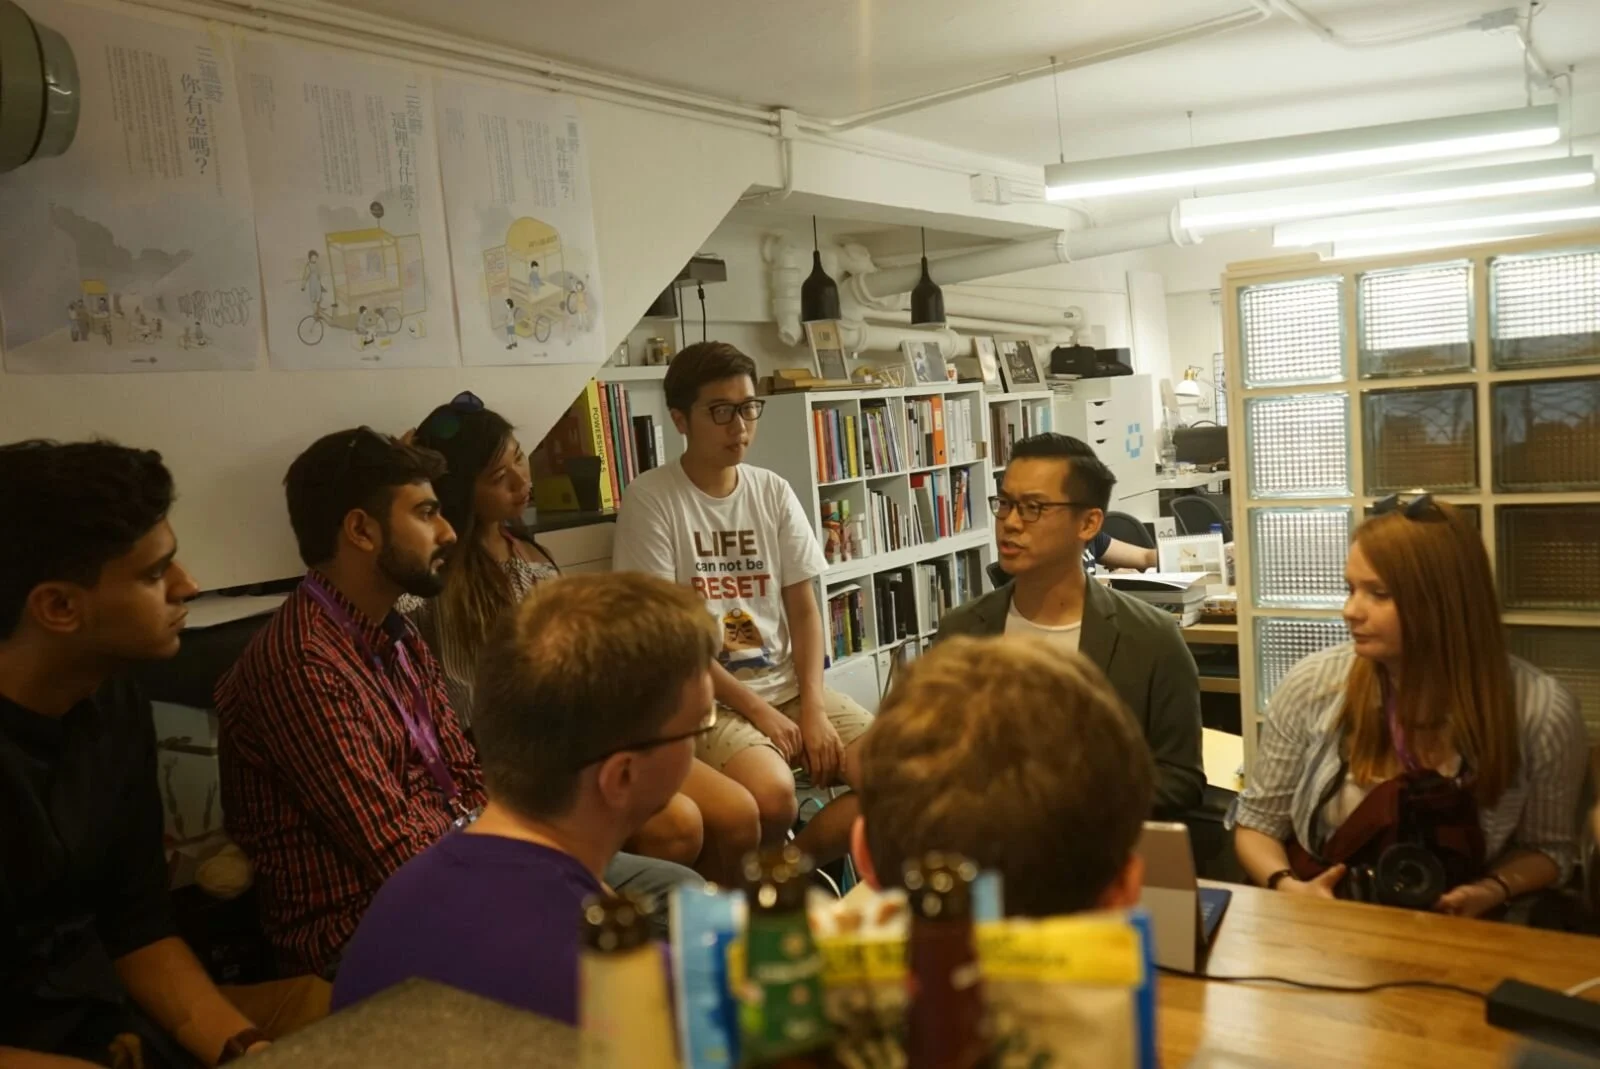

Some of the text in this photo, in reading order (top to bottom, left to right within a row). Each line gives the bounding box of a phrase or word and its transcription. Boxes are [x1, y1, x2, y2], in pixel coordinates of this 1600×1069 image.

[693, 529, 757, 557] LIFE
[696, 558, 764, 572] can not be
[691, 574, 771, 600] RESET
